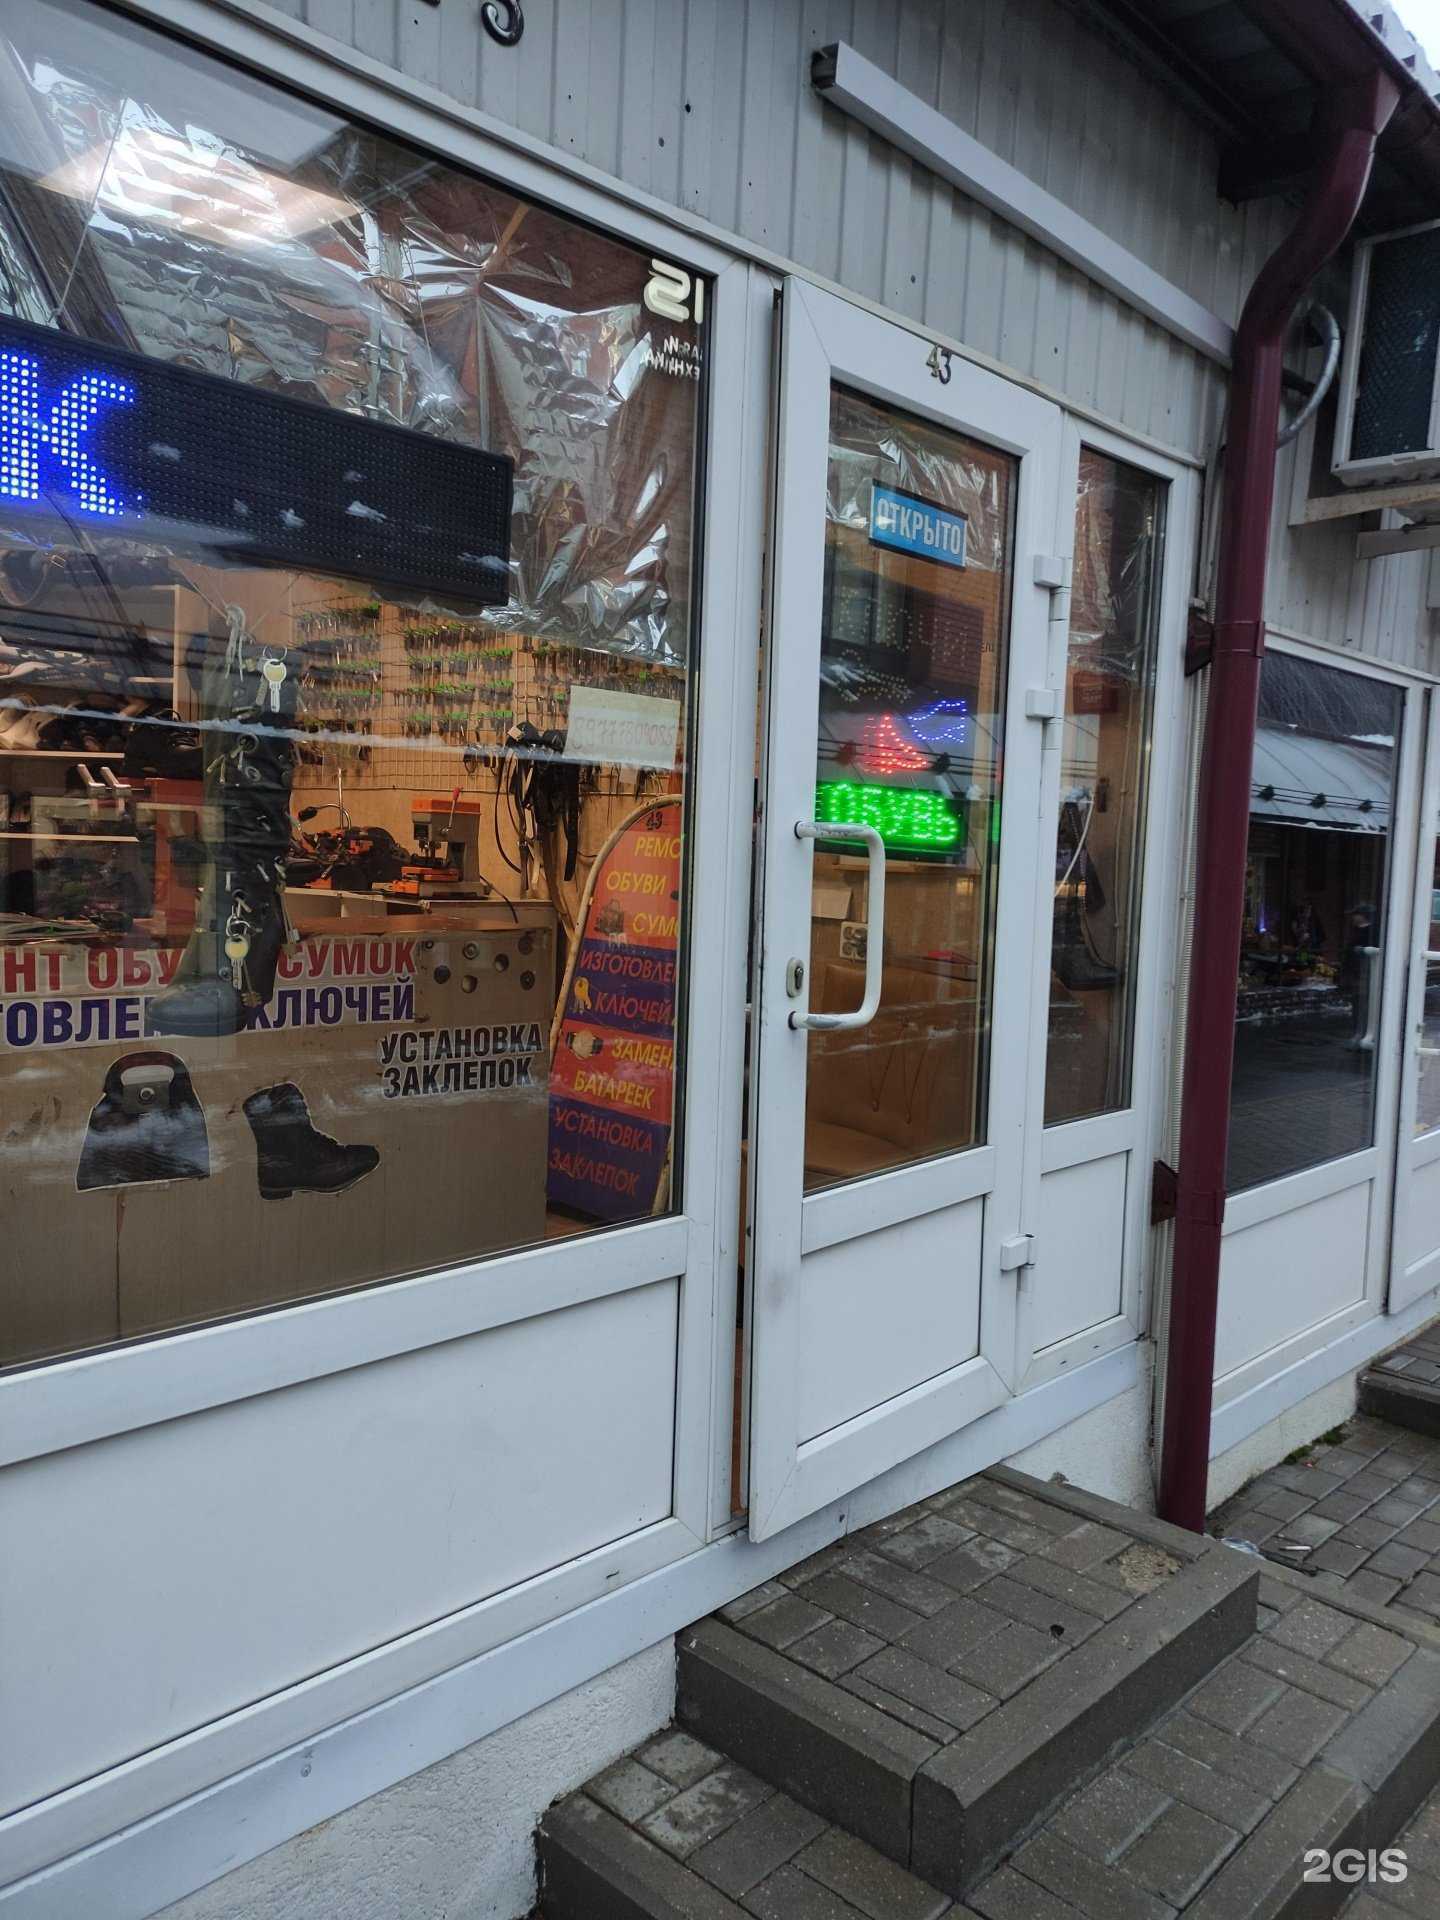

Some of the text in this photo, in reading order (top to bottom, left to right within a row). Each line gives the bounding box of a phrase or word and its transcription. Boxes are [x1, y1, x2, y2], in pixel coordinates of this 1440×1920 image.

[926, 344, 952, 385] 43
[876, 497, 962, 556] ОТКРЫТО
[606, 870, 668, 896] ОБУВИ
[276, 940, 417, 981] СУМОК
[580, 952, 677, 983] ИЗГОТОВЛЕ
[0, 975, 414, 1047] ОВЛЕ КЛЮЧЕЙ
[595, 991, 672, 1026] КЛЮЧЕЙ
[381, 1023, 543, 1065] УСТАНОВКА
[611, 1037, 675, 1071] ЗАМЕН
[383, 1056, 533, 1099] ЗАКЛЕПОК
[573, 1069, 655, 1110] БАТАРЕЕК
[554, 1106, 654, 1154] УСТАНОВКА
[548, 1149, 641, 1200] ЗАКЛЕПОК
